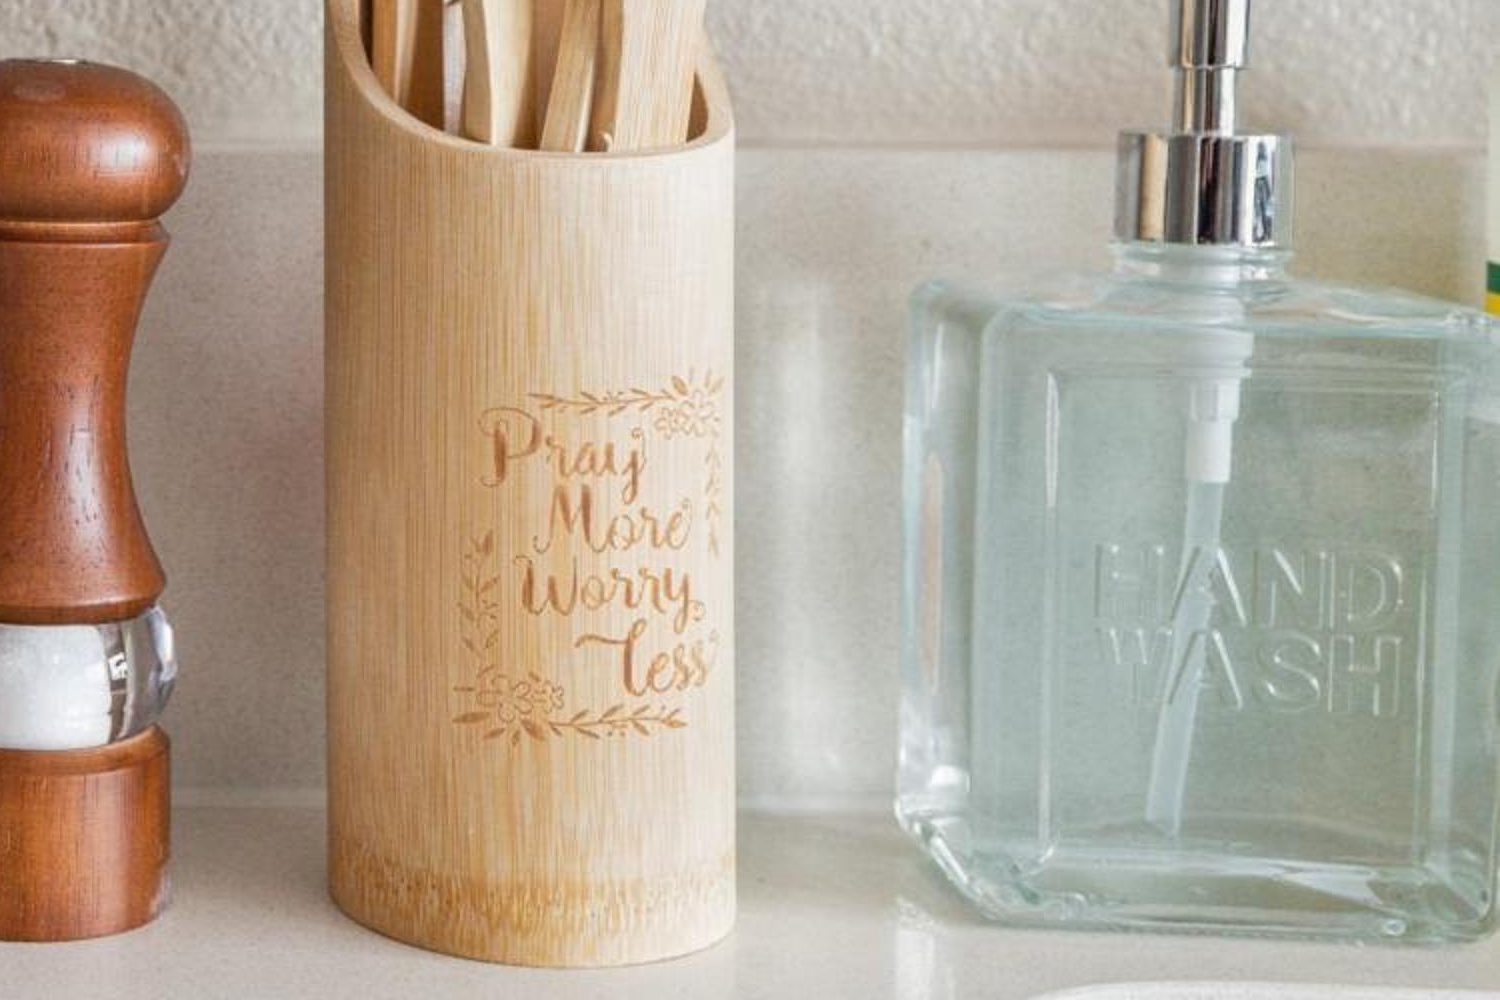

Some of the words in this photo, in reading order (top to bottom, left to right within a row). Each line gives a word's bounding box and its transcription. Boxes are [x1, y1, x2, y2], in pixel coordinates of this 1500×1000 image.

[476, 406, 646, 505] Pray
[532, 482, 692, 554] More
[512, 554, 706, 634] Worry
[1094, 543, 1404, 631] HAND
[574, 618, 719, 697] Less
[1094, 627, 1403, 717] WASH
